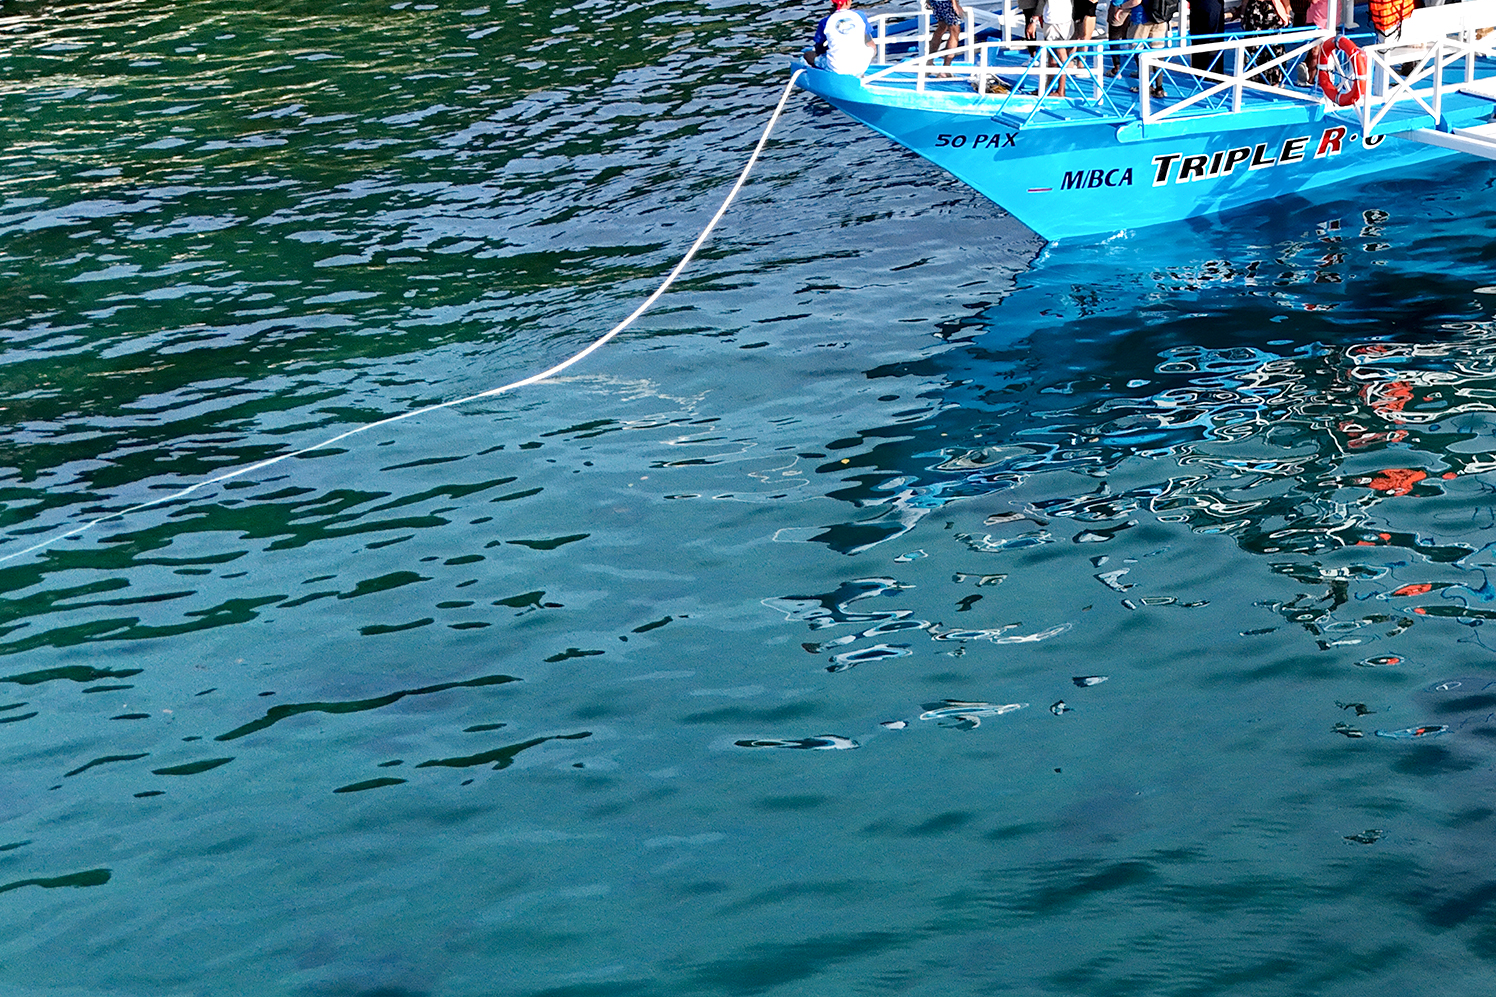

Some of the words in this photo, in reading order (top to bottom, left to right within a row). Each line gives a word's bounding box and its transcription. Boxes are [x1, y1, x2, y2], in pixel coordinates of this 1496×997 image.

[934, 133, 967, 149] 50
[972, 132, 1019, 149] PAX
[1060, 167, 1133, 190] M/BCA
[1153, 136, 1311, 186] TRIPLE
